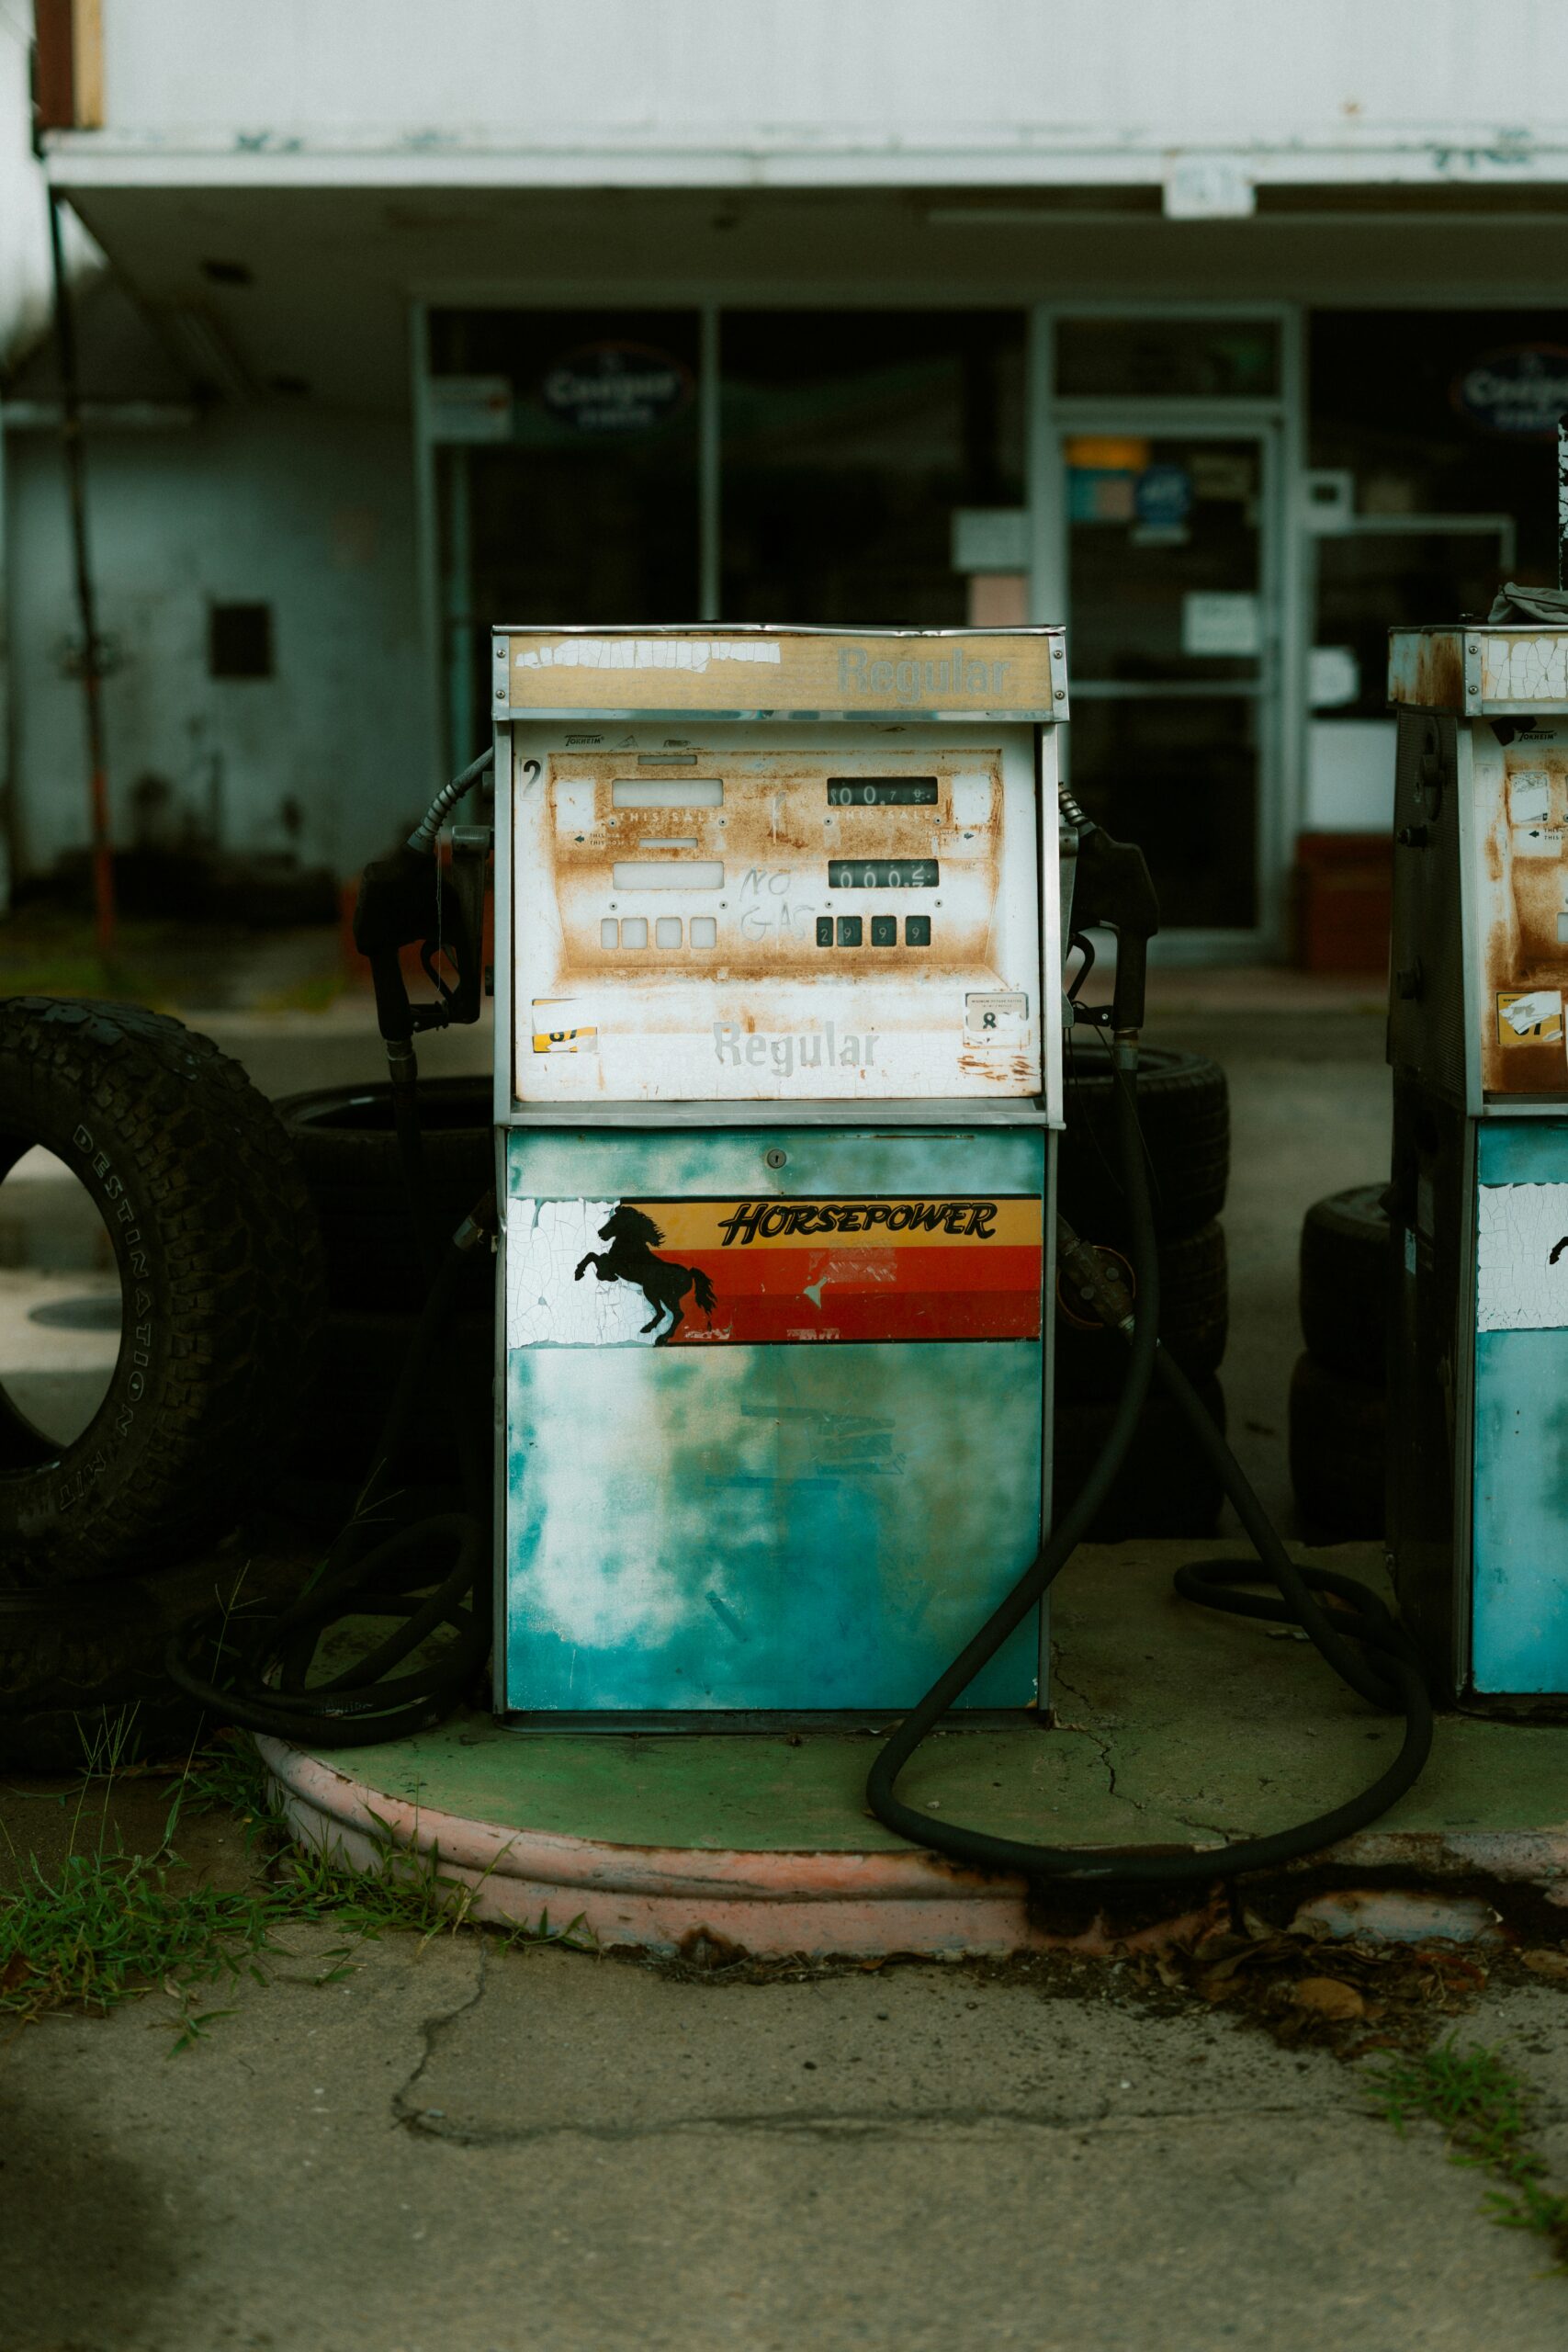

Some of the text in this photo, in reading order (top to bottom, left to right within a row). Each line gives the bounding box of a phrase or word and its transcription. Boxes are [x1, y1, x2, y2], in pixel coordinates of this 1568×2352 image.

[838, 647, 1010, 705] Regular
[523, 760, 541, 798] 2
[618, 812, 716, 822] THIS SALE
[887, 810, 931, 820] SALE
[739, 867, 792, 902] NO
[740, 902, 816, 942] GAS
[713, 1021, 879, 1077] Regular
[717, 1203, 998, 1247] HORSEPOWER
[73, 1124, 152, 1437] DESTINATION
